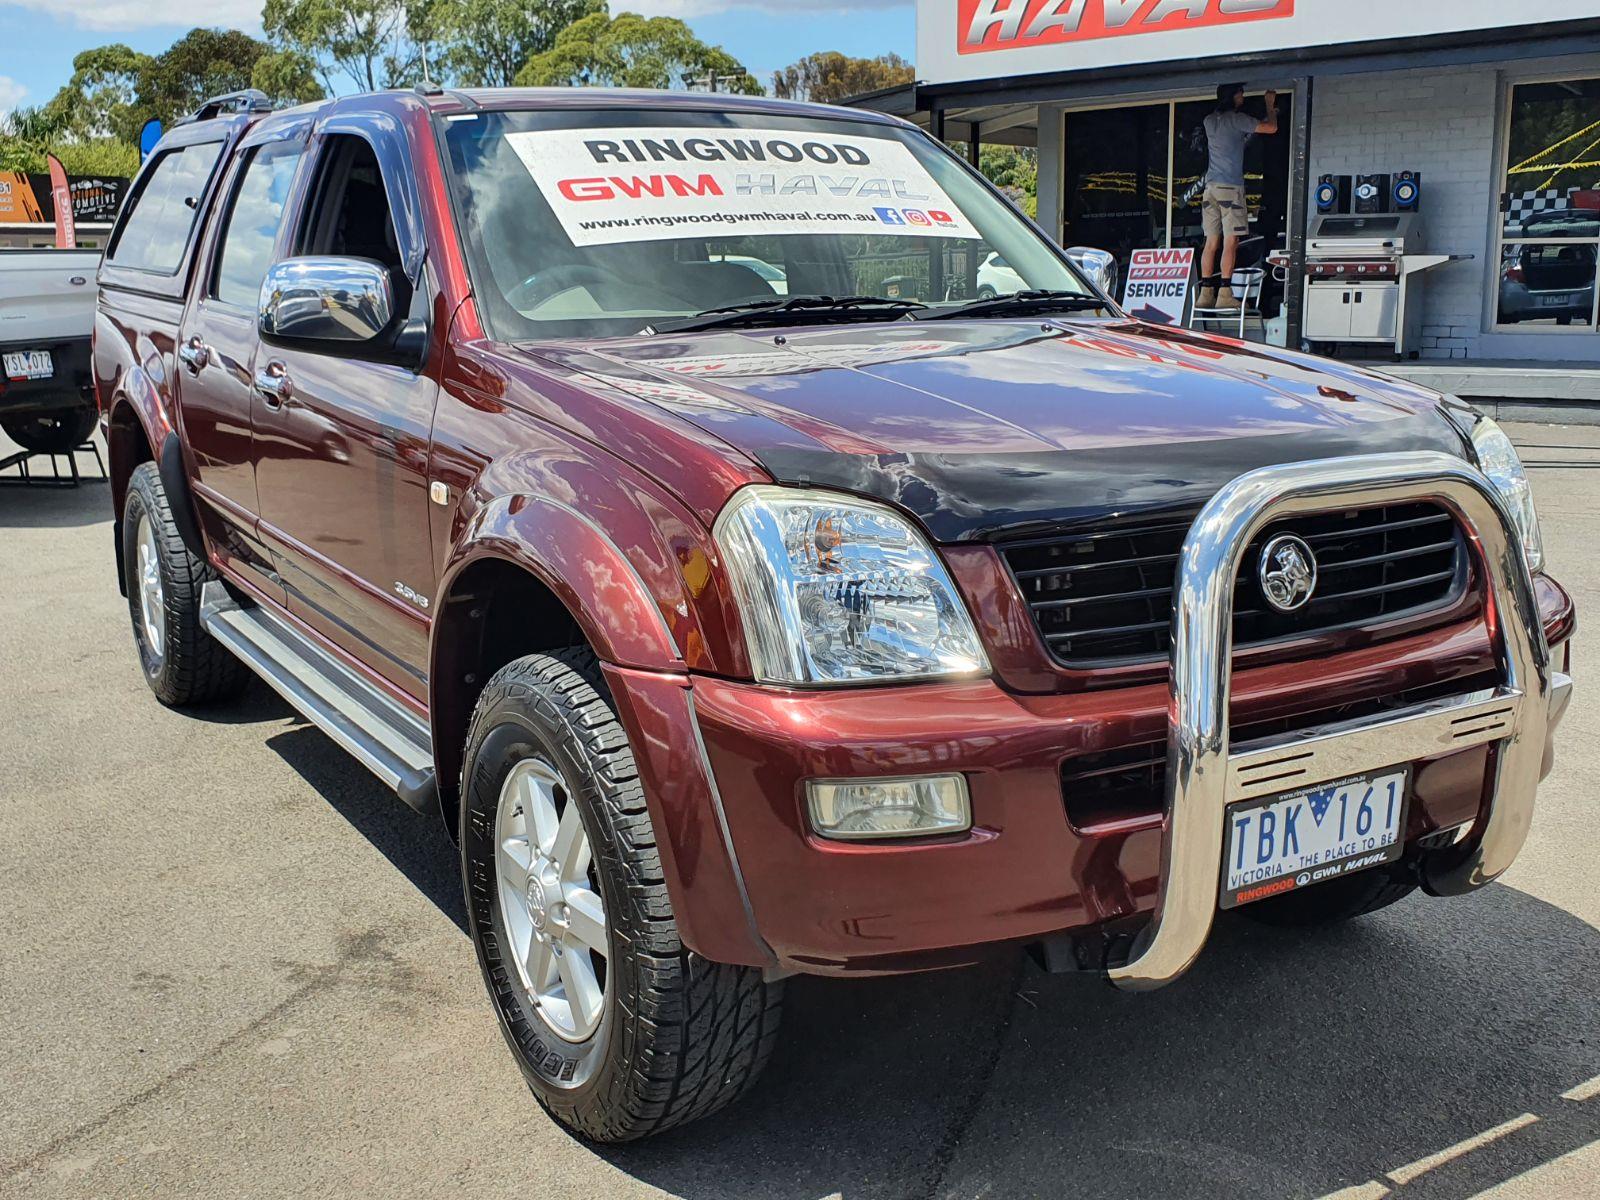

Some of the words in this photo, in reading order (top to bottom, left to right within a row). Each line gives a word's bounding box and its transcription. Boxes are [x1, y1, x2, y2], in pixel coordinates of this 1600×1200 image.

[965, 0, 1282, 45] HAV
[583, 138, 871, 166] RINGWOOD
[72, 186, 104, 199] ATIONAL
[556, 174, 724, 202] GWM
[734, 173, 930, 201] HAVAL
[1183, 176, 1205, 202] HAV
[579, 209, 876, 231] www.ringwoodgwmhaval.com.au
[1132, 250, 1192, 265] GWM
[1131, 268, 1184, 278] HAVAL
[1126, 283, 1185, 298] SERVICE
[3, 354, 26, 372] YSL
[32, 352, 52, 369] 072
[1235, 804, 1303, 870] TBK
[1338, 781, 1396, 842] 161
[1231, 863, 1283, 887] VICTORIA
[1299, 852, 1319, 867] THE
[1325, 843, 1356, 861] PLACE
[1362, 837, 1375, 850] TO
[1236, 878, 1295, 903] RINGWOOD
[1313, 865, 1341, 880] GWM
[1344, 852, 1388, 871] HAVAL
